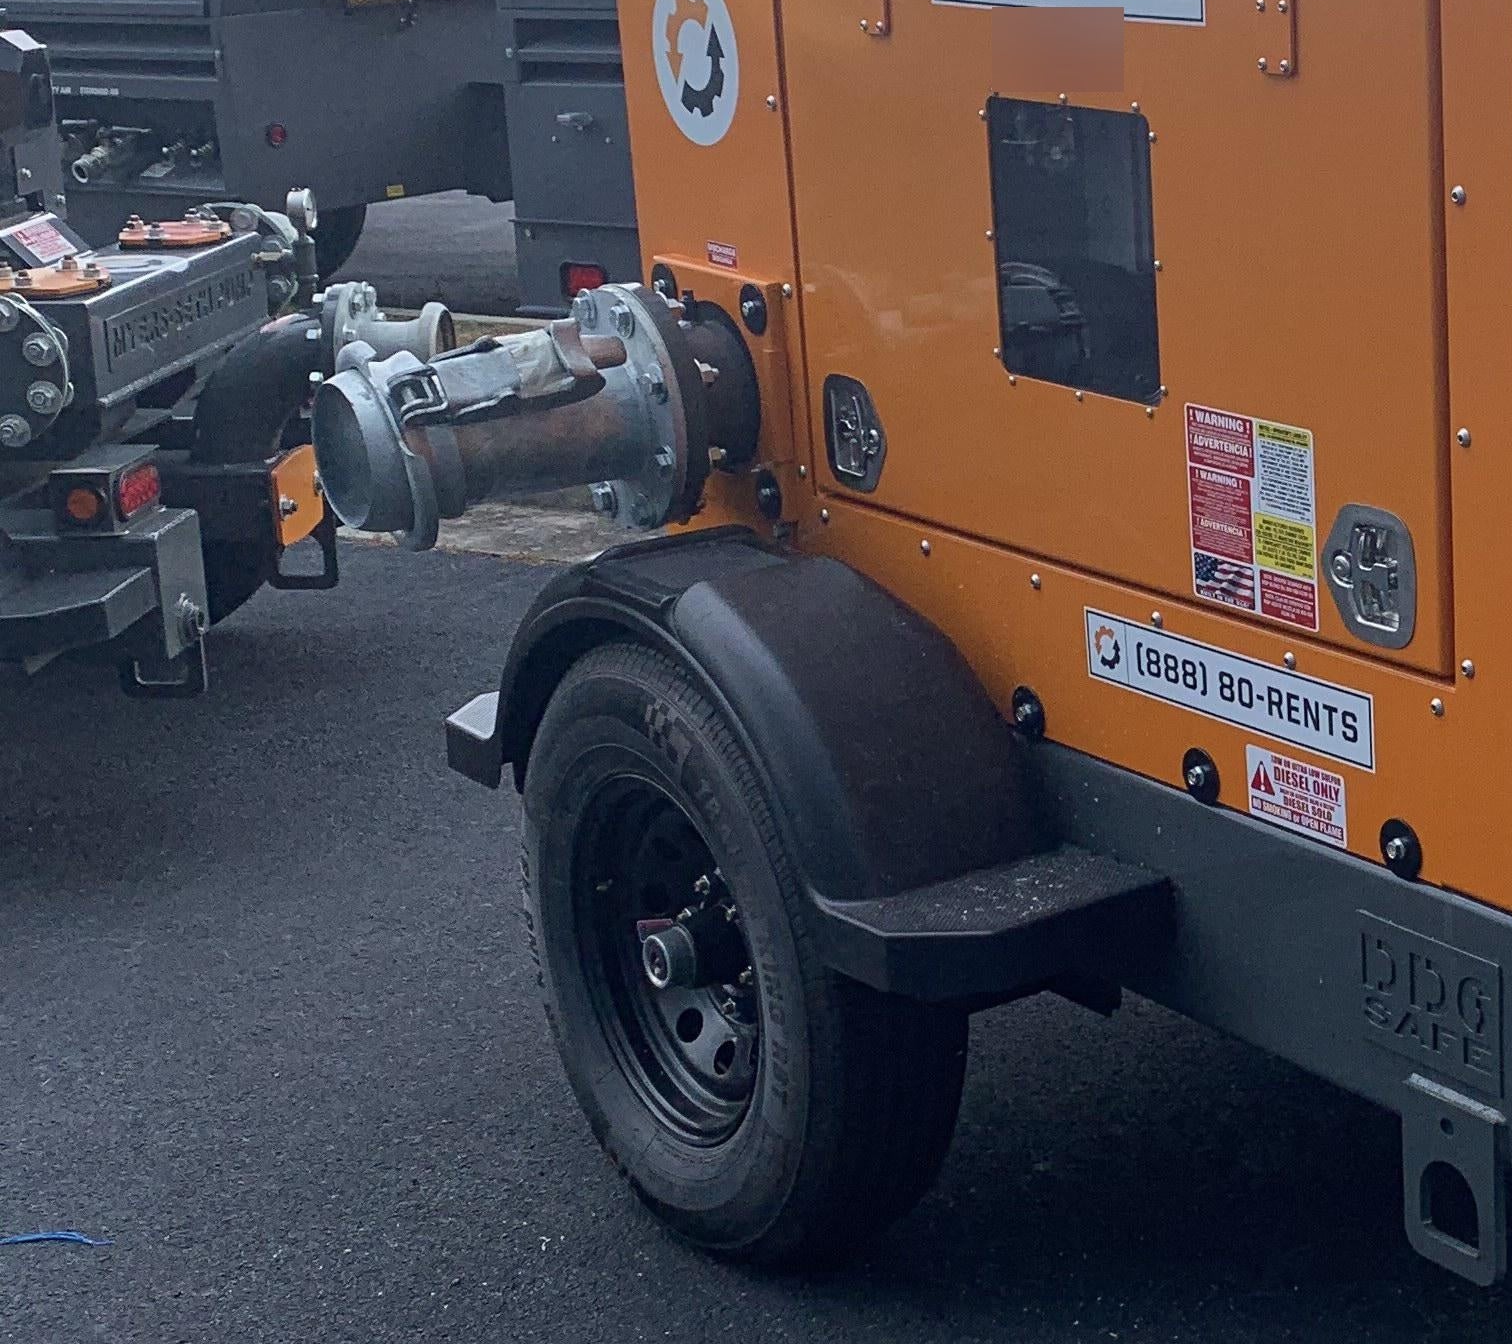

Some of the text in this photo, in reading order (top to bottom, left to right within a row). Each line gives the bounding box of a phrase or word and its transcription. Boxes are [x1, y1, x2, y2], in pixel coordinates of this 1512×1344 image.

[1194, 409, 1244, 433] WARNING
[1199, 469, 1238, 488] WARNING
[1136, 641, 1358, 744] (888) 80-RENTS
[1273, 766, 1310, 793] DIESEL
[1313, 779, 1340, 803] ONLY
[1283, 795, 1310, 814] DIESEL
[1301, 814, 1319, 831] OPEN
[1363, 996, 1492, 1077] SAFE
